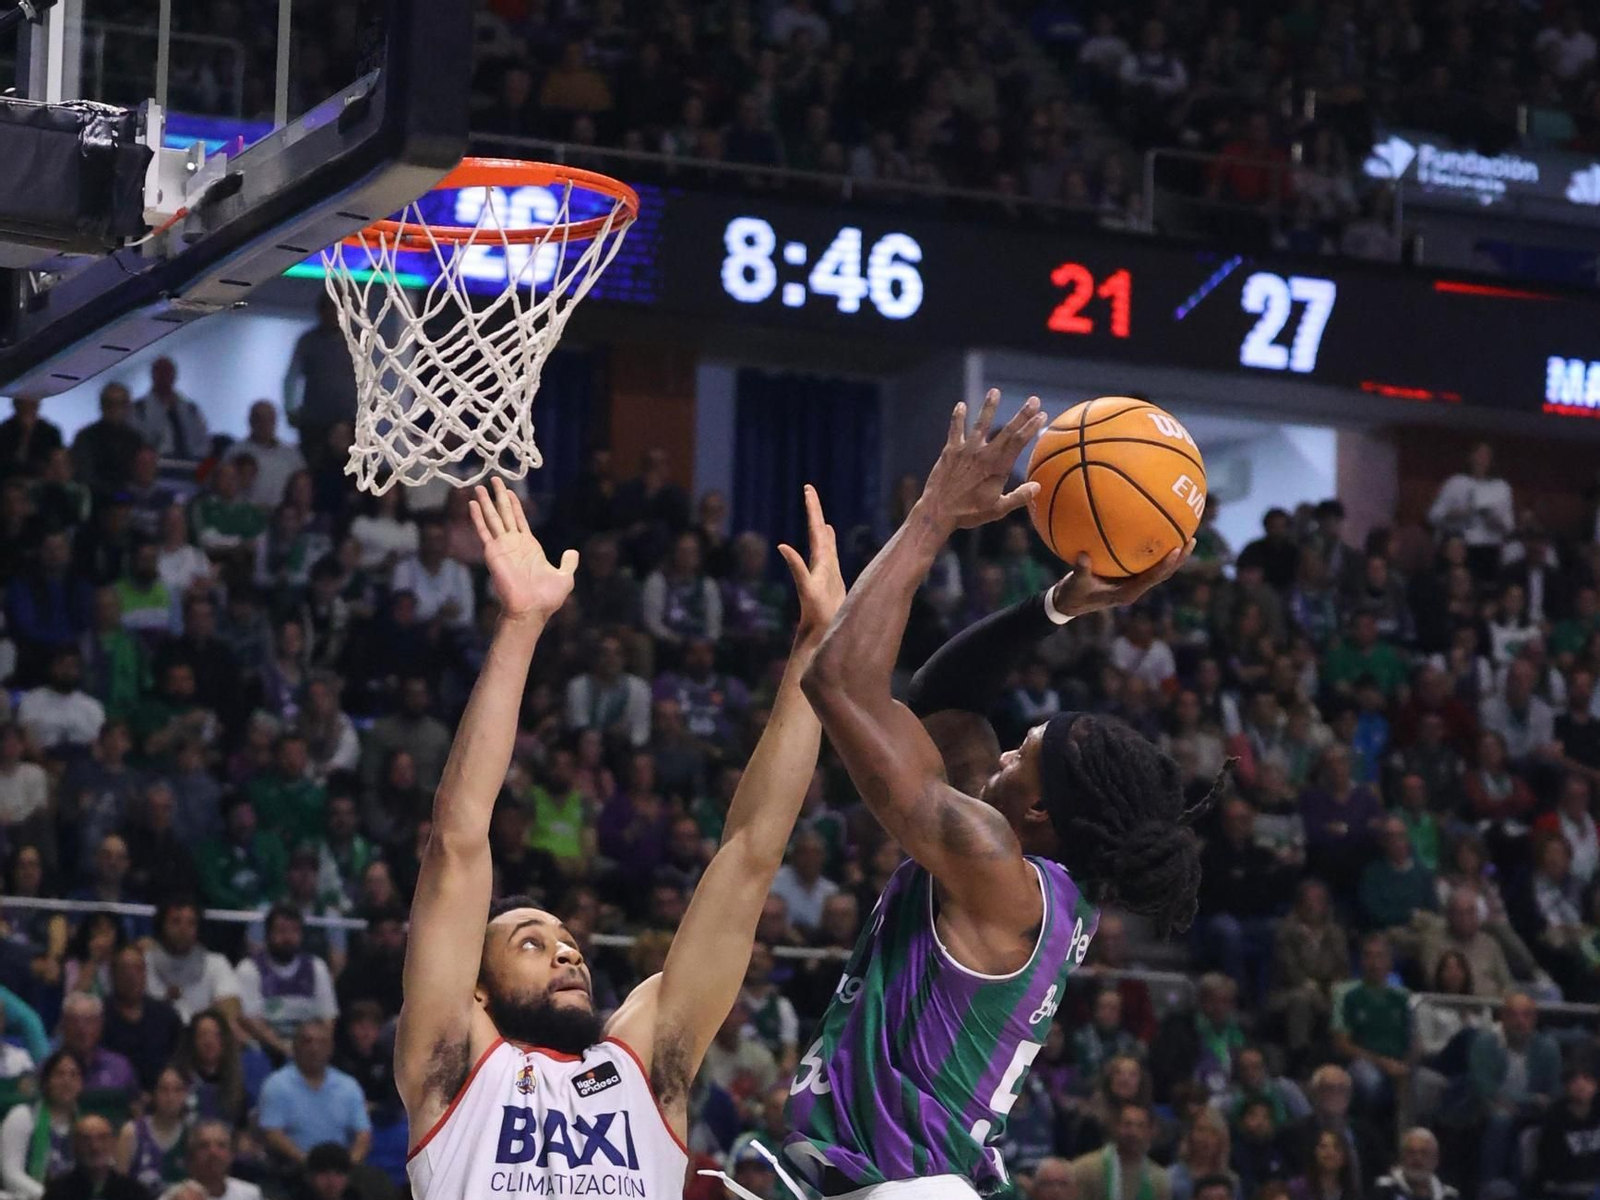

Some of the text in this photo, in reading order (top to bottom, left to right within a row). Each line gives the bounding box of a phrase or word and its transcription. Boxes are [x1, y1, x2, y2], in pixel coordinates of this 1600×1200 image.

[721, 216, 924, 319] 8:46
[1047, 262, 1132, 338] 21
[1240, 272, 1336, 373] 27
[576, 1077, 596, 1089] liga
[580, 1075, 619, 1095] endesa
[495, 1104, 640, 1171] BAXI
[490, 1170, 646, 1198] CLIMATIZACIÓN
